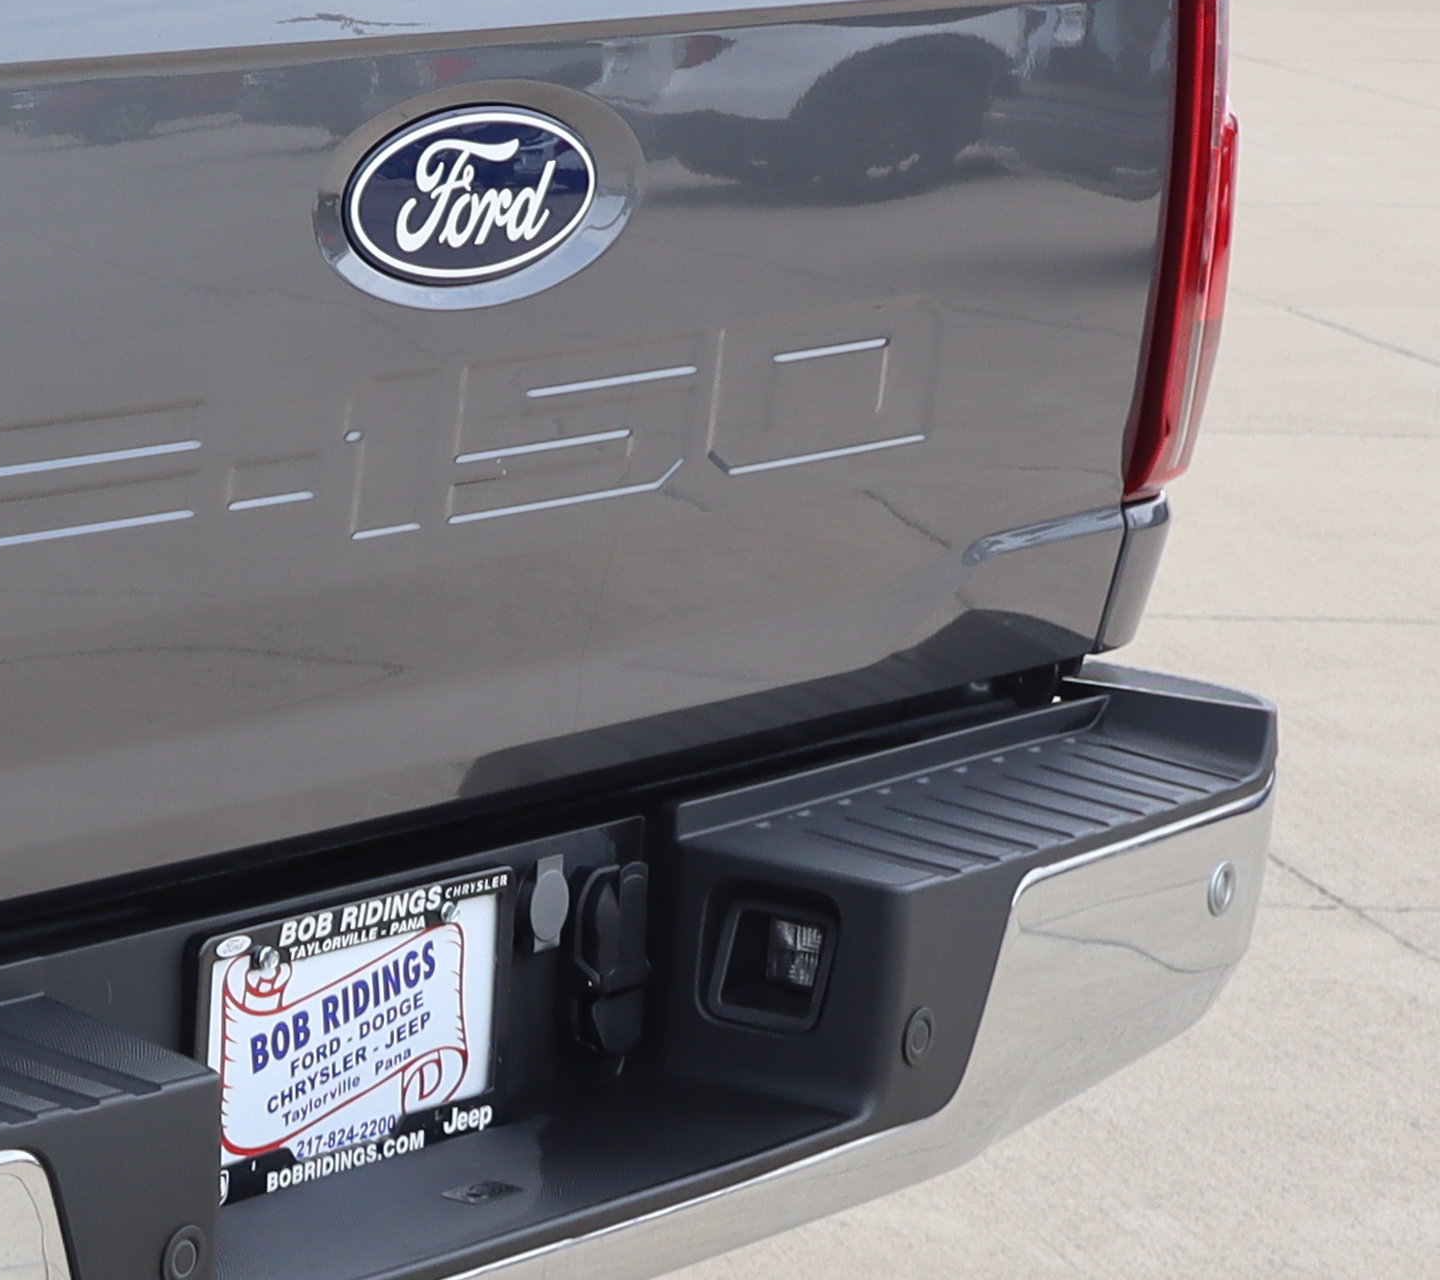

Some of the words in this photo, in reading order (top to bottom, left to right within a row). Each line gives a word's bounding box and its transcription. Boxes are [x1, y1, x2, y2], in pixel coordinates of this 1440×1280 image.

[394, 137, 557, 253] Ford
[278, 911, 334, 948] BOB
[340, 885, 443, 933] RIDINGS
[444, 873, 509, 900] CHRYSLER
[288, 925, 378, 961] TAYLORVILLE
[389, 914, 427, 936] PANA
[250, 1009, 311, 1075] BOB
[321, 939, 437, 1032] RIDINGS
[290, 1035, 342, 1078] FORD
[359, 991, 425, 1040] DODGE
[267, 1048, 368, 1114] CHRYSLER
[385, 1011, 432, 1053] JEEP
[282, 1075, 361, 1127] Taylorville
[374, 1047, 412, 1075] Pana
[296, 1113, 398, 1159] 217-824-2200
[442, 1104, 494, 1136] Jeep
[266, 1129, 425, 1194] BOBRIDINGS.COM
